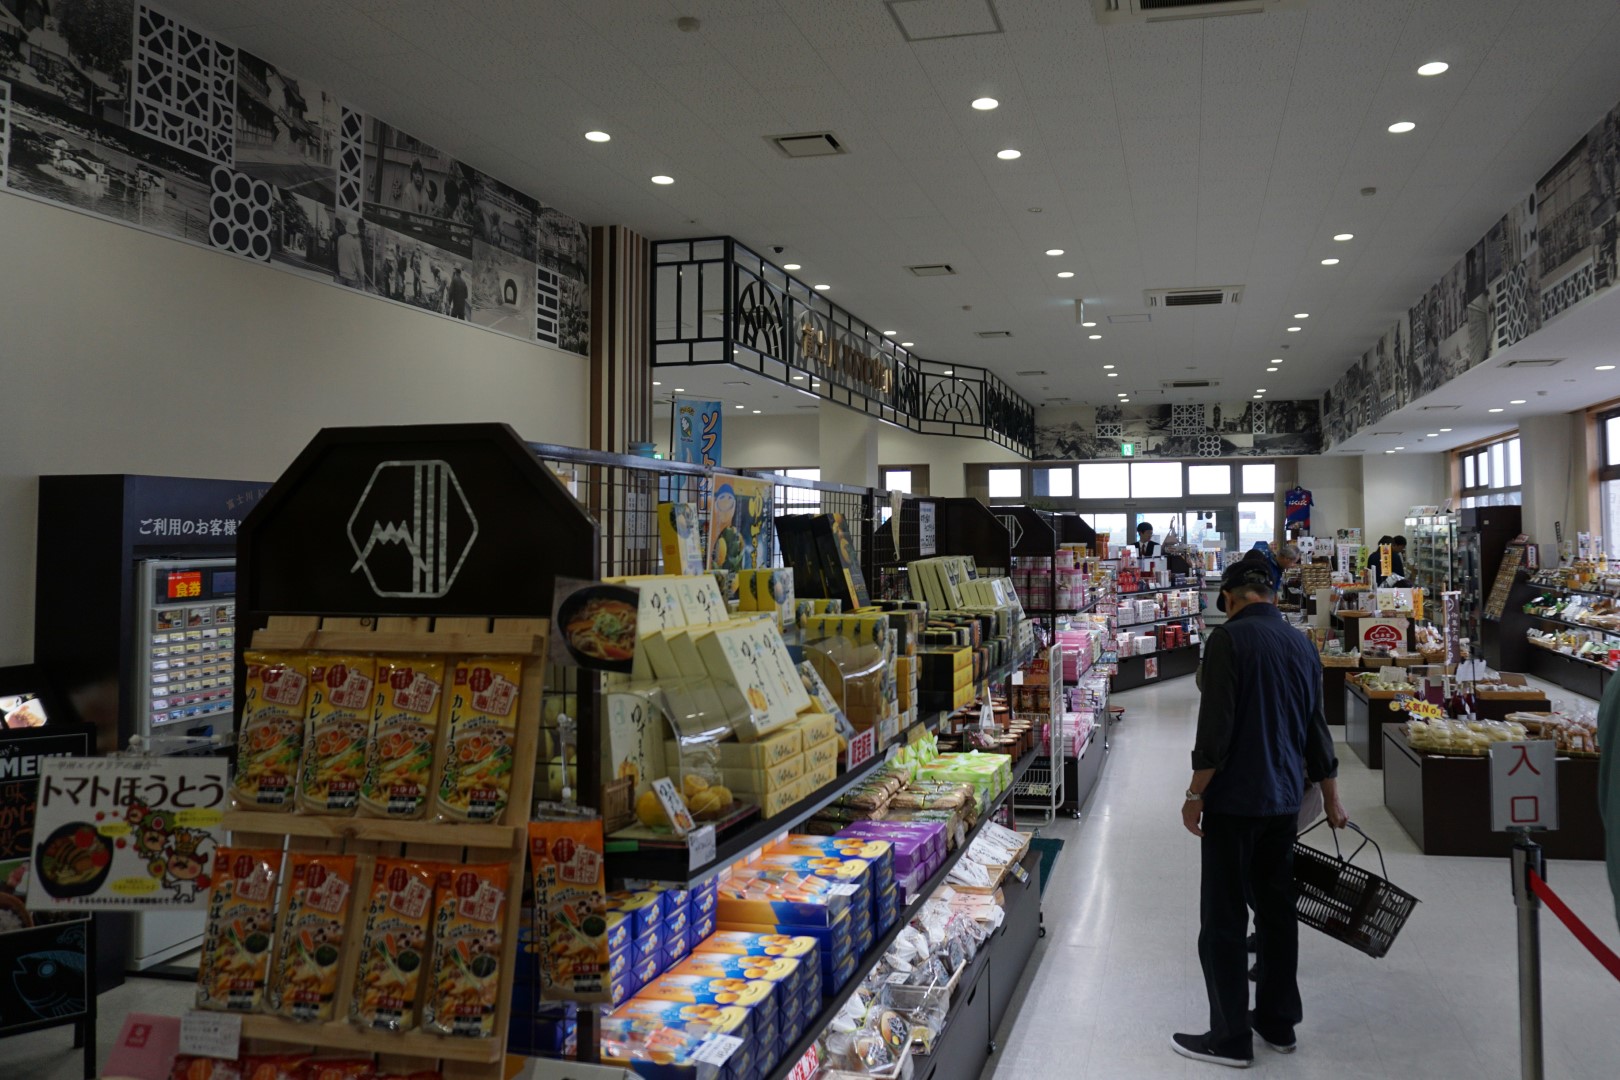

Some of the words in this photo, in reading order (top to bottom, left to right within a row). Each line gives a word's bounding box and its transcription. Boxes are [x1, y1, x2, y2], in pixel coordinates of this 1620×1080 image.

[139, 517, 243, 536] ご利用のお客様
[176, 582, 201, 598] 食券
[303, 691, 322, 782] カレーうどん
[364, 692, 385, 785] カレーうどん
[440, 693, 463, 789] カレーうどん
[42, 775, 224, 808] トマトほうとう
[1508, 745, 1541, 823] 入口
[536, 873, 553, 989] あばれほうとう
